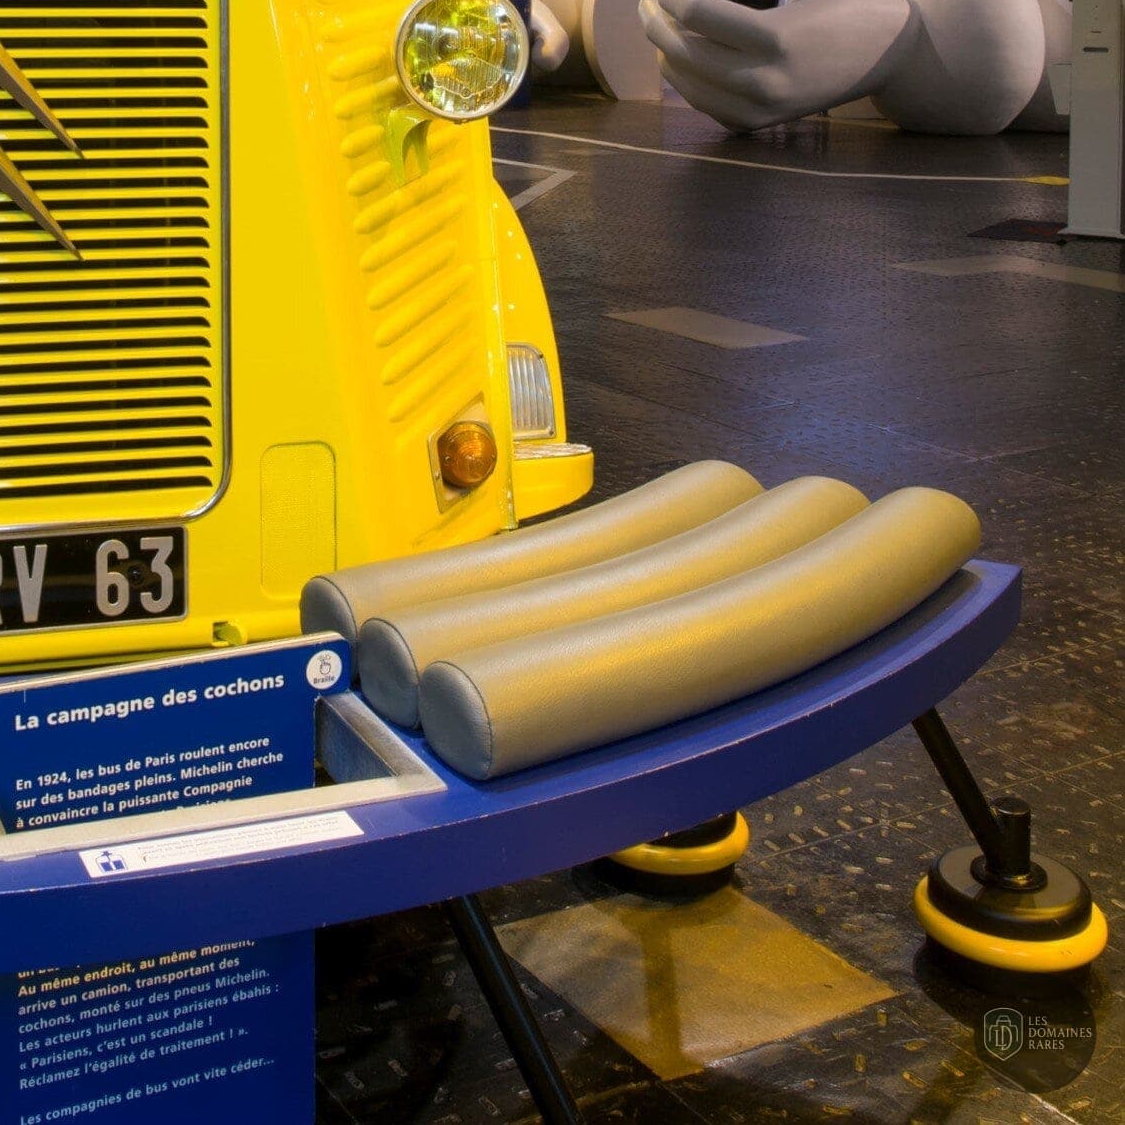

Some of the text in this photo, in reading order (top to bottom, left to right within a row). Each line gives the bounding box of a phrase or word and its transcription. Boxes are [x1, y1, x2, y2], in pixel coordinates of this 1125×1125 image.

[96, 536, 174, 617] 63
[15, 675, 285, 731] La campagne des cochons
[16, 737, 270, 791] En 1924, les bus de Paris roulent encore
[16, 752, 284, 810] sur des bandages pleins. Michelin cherche
[16, 817, 25, 829] à
[28, 805, 99, 826] convaincre
[102, 801, 115, 813] la
[119, 789, 180, 812] puissante
[183, 776, 253, 797] Compagnie
[18, 985, 36, 997] Au
[40, 974, 81, 992] même
[84, 962, 136, 982] endroit,
[139, 958, 156, 971] au
[159, 949, 197, 966] même
[18, 956, 241, 1016] arrive un camion, transportant des
[18, 968, 270, 1034] cochons, monté sur des pneus Michelin.
[18, 1039, 41, 1053] Les
[44, 1027, 93, 1047] acteurs
[96, 1015, 143, 1035] hurlent
[146, 1009, 170, 1023] aux
[173, 994, 229, 1019] parisiens
[232, 984, 272, 1002] ébahis
[31, 1046, 93, 1069] Parisiens,
[130, 1032, 147, 1045] un
[150, 1018, 205, 1041] scandale
[19, 1066, 81, 1090] Réclamez
[140, 1047, 156, 1061] de
[160, 1031, 225, 1056] traitement
[20, 1112, 42, 1125] Les
[45, 1092, 123, 1117] compagnies
[126, 1086, 142, 1101] de
[145, 1081, 168, 1096] bus
[171, 1073, 201, 1089] vont
[203, 1067, 228, 1081] vite
